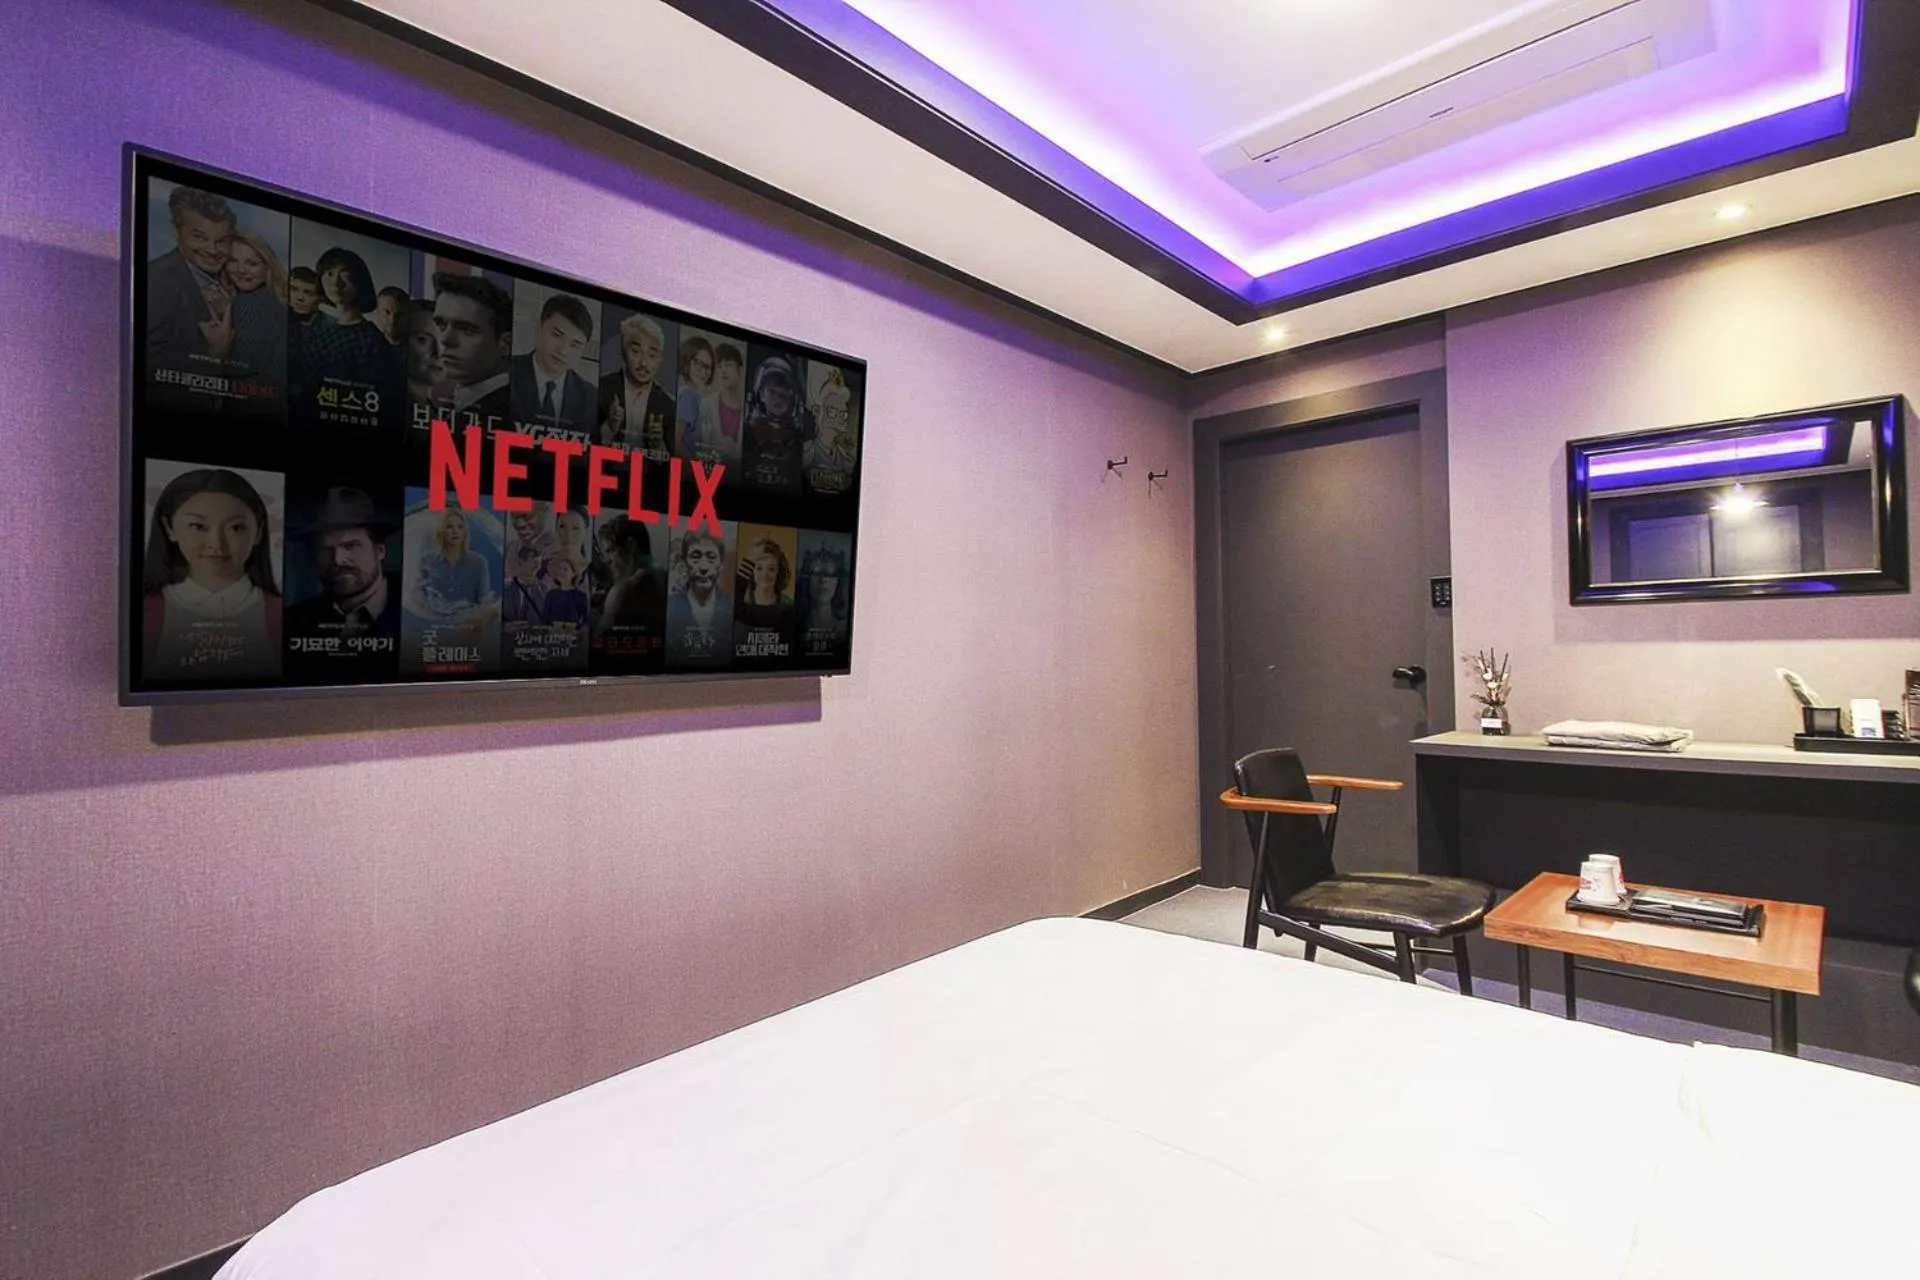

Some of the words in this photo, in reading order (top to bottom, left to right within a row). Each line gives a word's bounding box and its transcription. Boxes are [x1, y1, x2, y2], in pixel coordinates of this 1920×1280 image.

[316, 386, 380, 412] 센스8
[429, 418, 726, 539] NETFLIX
[289, 637, 341, 653] 기묘한
[347, 636, 394, 652] 이야기
